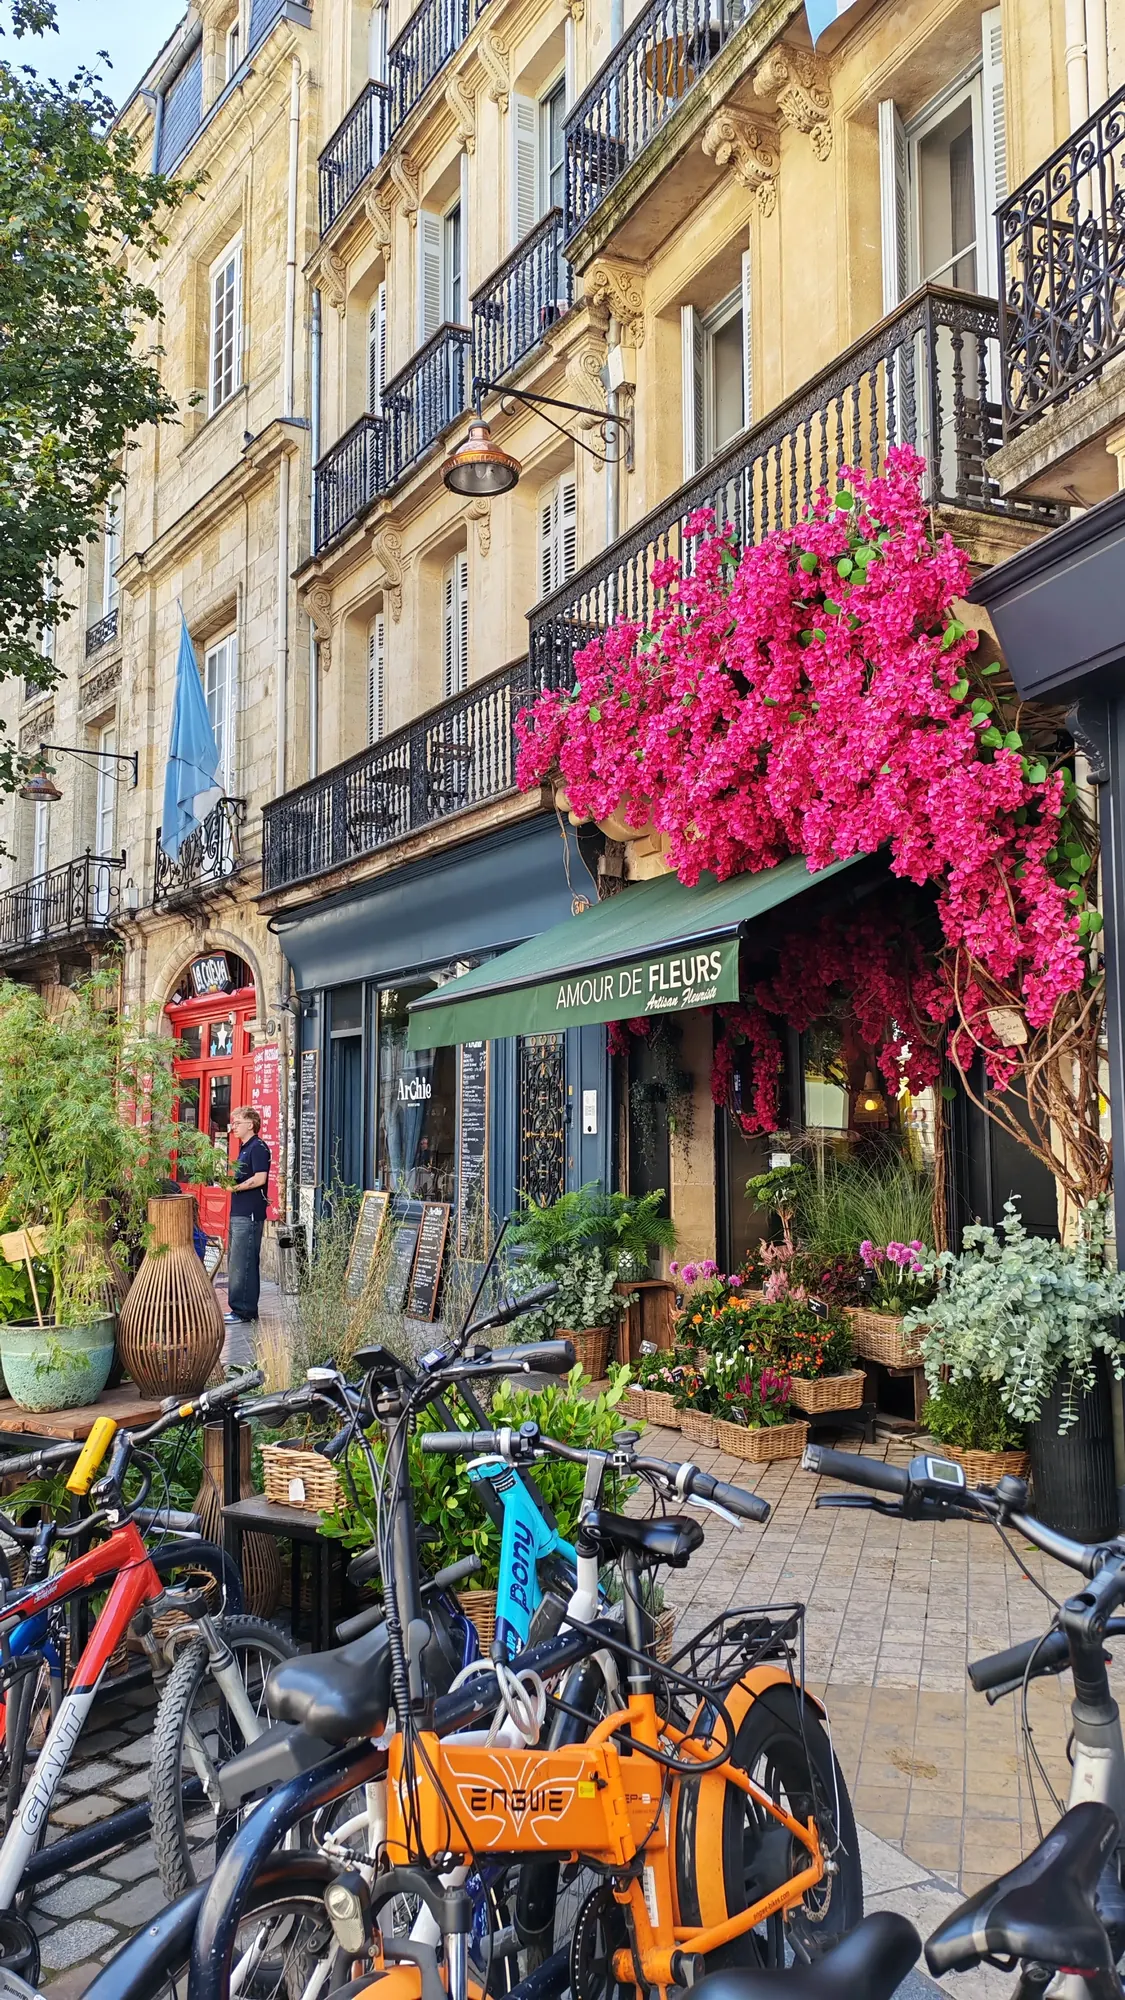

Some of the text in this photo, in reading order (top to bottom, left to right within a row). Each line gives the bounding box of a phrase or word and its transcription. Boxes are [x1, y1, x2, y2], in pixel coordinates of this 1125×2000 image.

[556, 951, 722, 1010] AMOUR DE FLEURS
[645, 985, 717, 1012] Artisan Fleuriste
[510, 1520, 535, 1615] pony
[21, 1702, 81, 1835] GIANT
